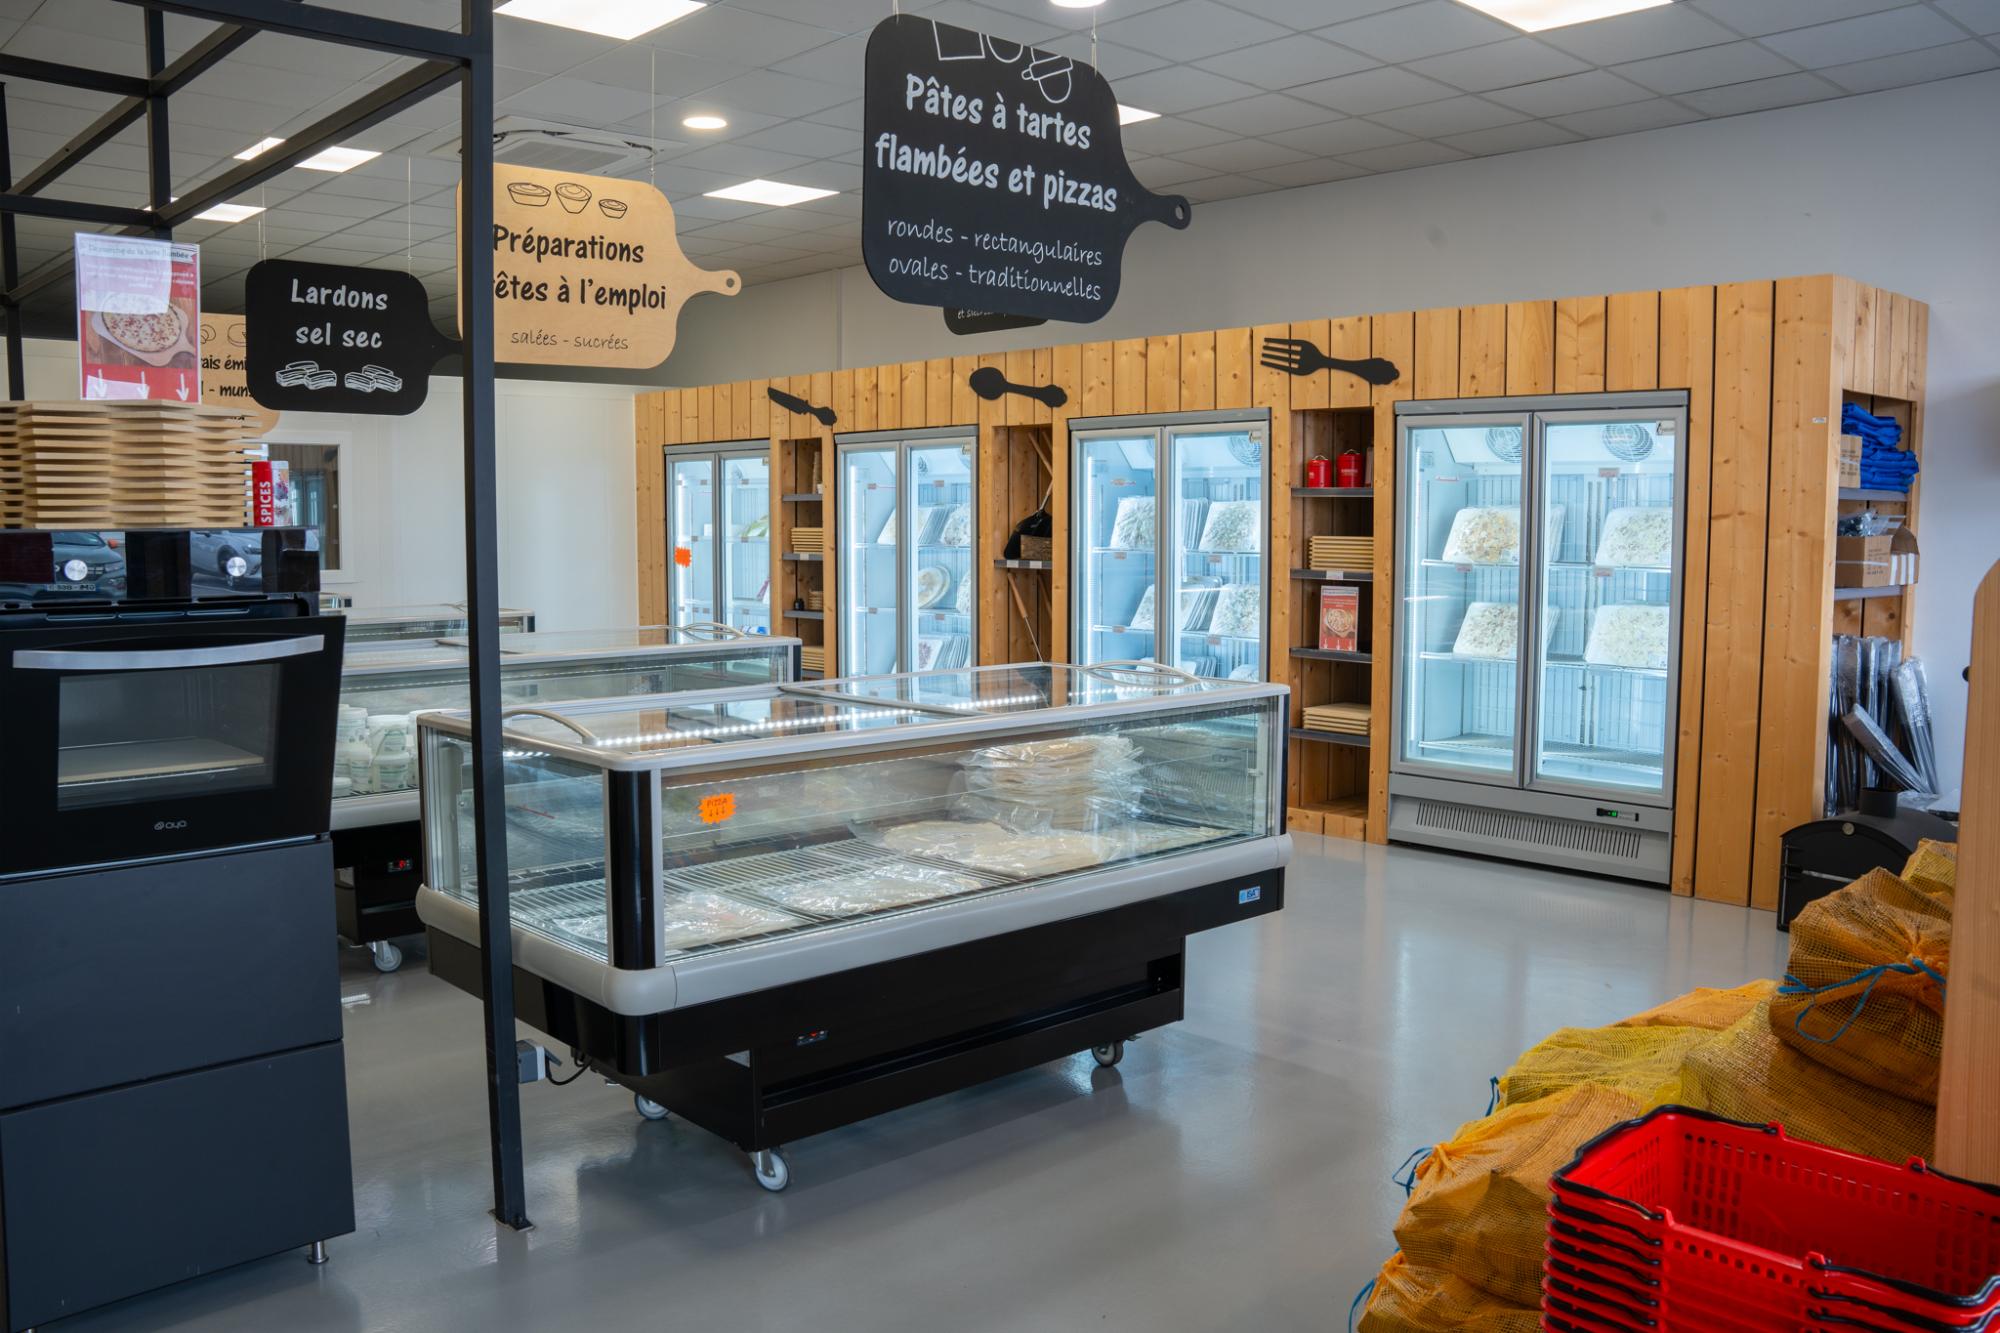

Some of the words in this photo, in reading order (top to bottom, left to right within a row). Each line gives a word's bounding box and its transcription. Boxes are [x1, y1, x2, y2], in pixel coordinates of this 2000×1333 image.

[905, 73, 984, 125] Pâtes
[991, 91, 1007, 130] à
[1016, 102, 1091, 150] tartes
[874, 132, 1000, 189] flambées
[1007, 164, 1036, 196] et
[1043, 170, 1118, 213] pizzas
[493, 224, 645, 264] Préparations
[888, 218, 954, 244] rondes
[974, 232, 1103, 266] rectangulaires
[290, 278, 388, 311] Lardons
[493, 270, 549, 302] êtes
[557, 275, 570, 304] à
[580, 278, 667, 316] l'emploi
[888, 256, 949, 281] ovales
[968, 264, 1102, 301] traditionnelles
[295, 322, 332, 346] sel
[342, 329, 383, 349] sec
[511, 330, 559, 346] salées
[573, 333, 629, 350] sucrées
[201, 354, 221, 370] ais
[260, 481, 273, 523] SPICES
